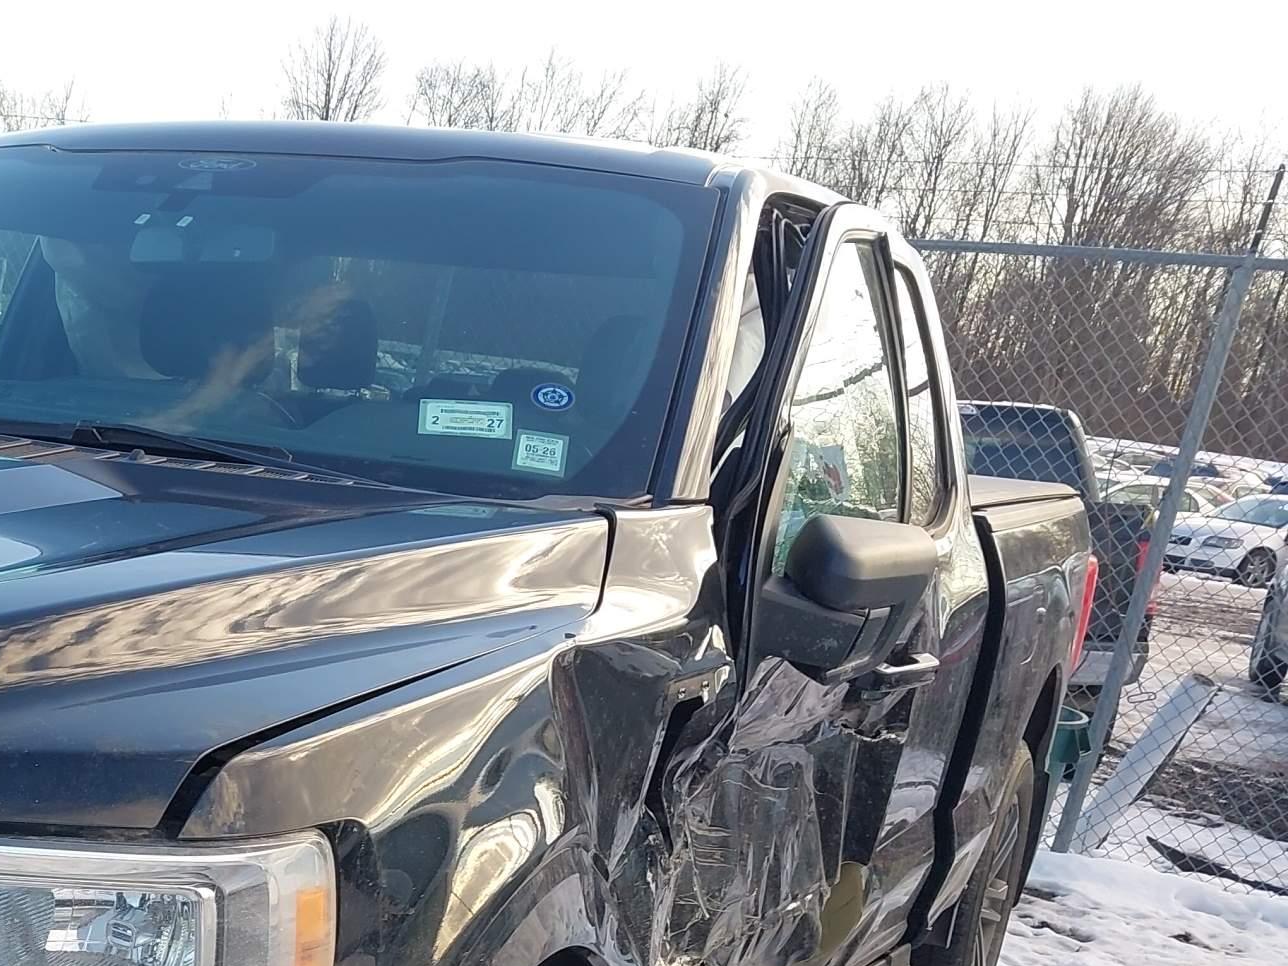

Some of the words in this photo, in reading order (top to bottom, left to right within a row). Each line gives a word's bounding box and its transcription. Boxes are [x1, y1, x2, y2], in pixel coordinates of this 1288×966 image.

[431, 415, 440, 425] 2
[487, 418, 504, 429] 27
[525, 443, 539, 454] 05
